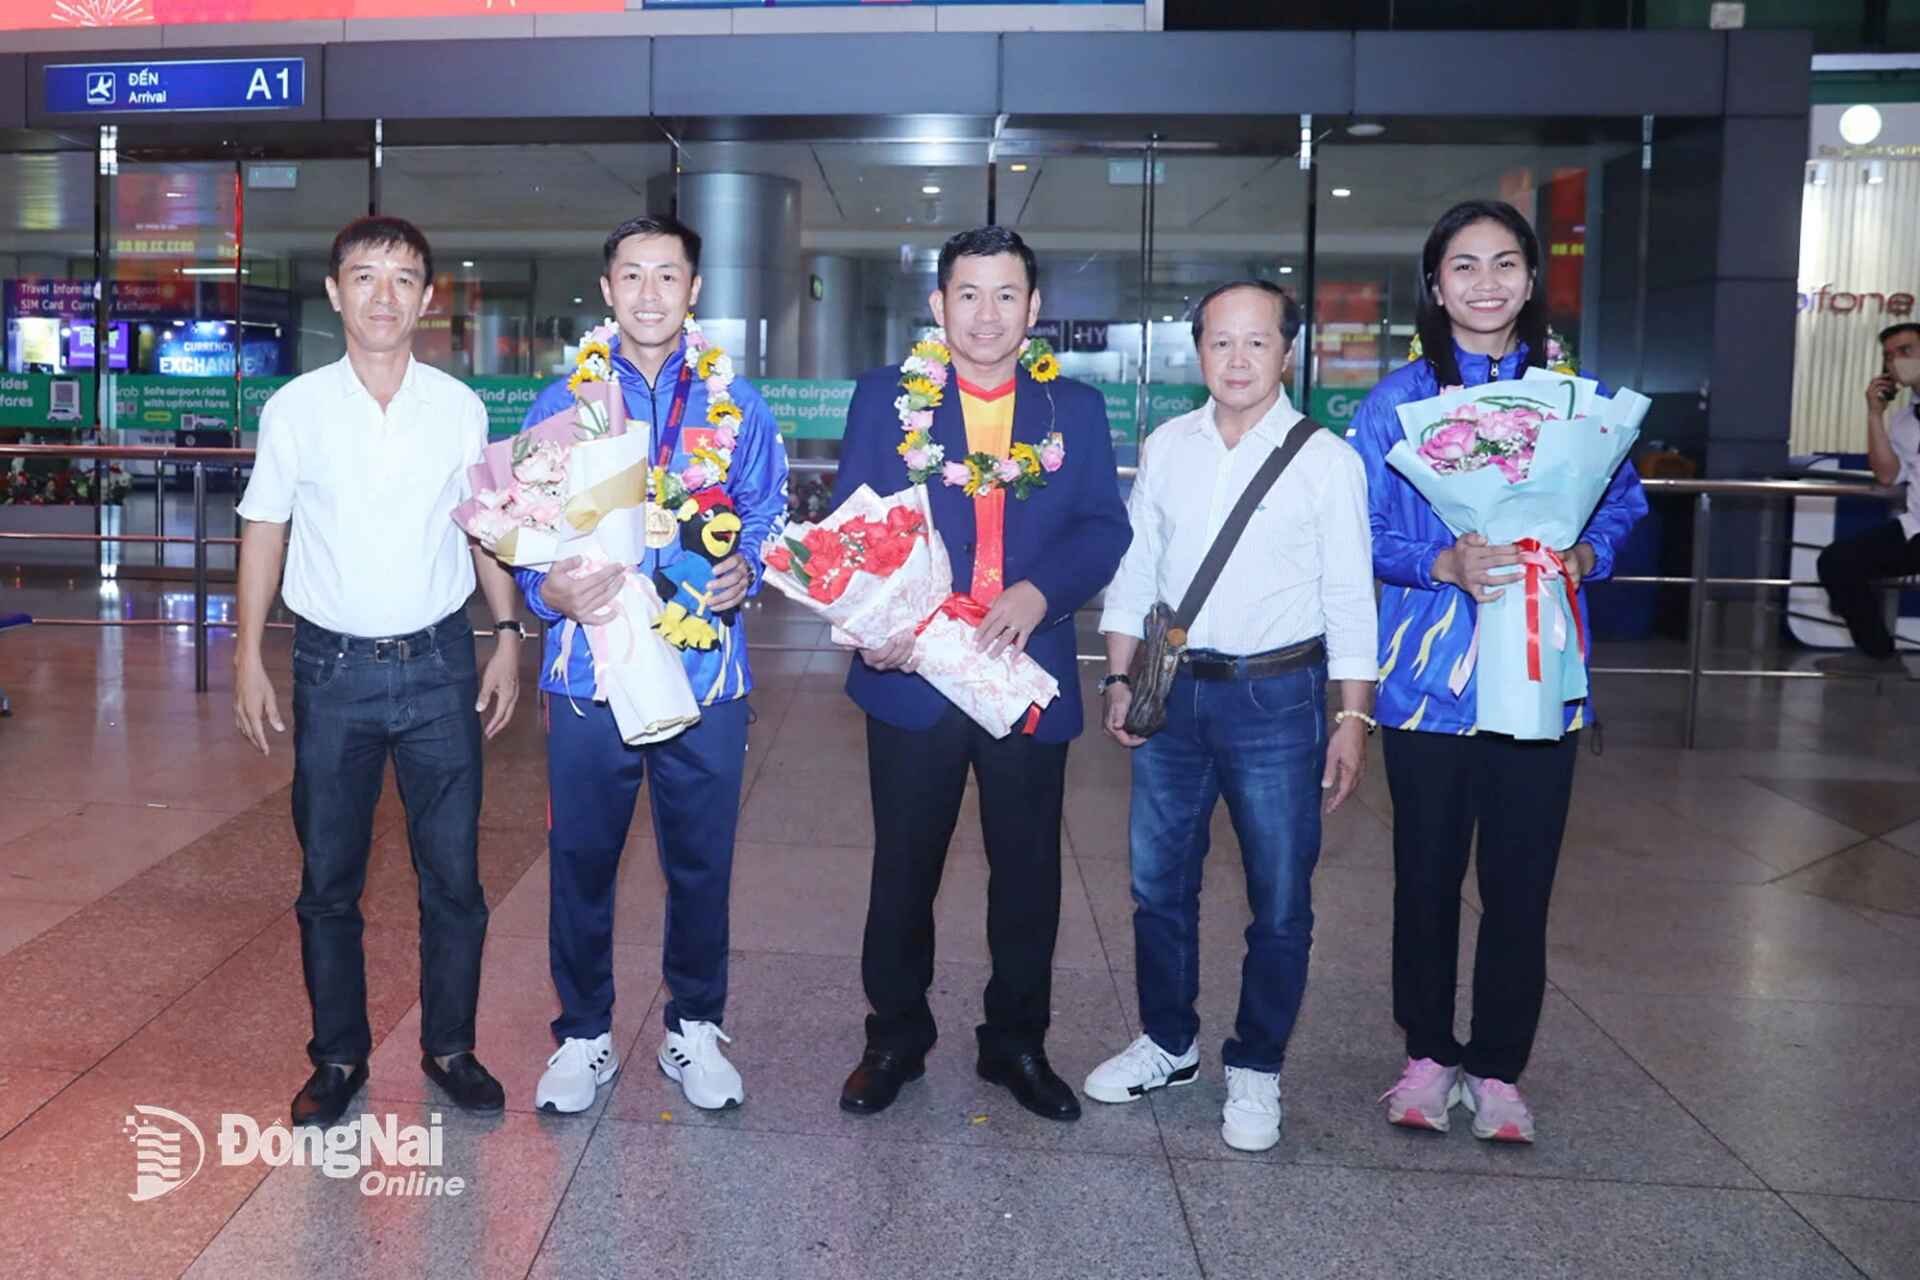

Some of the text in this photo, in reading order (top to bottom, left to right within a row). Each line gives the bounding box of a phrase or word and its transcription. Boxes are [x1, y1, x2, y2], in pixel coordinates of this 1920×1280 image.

[128, 69, 159, 86] ĐẾN
[246, 68, 289, 100] A1
[128, 91, 166, 104] Arrival
[183, 342, 234, 352] CURRENCY
[0, 378, 28, 390] ides
[114, 386, 140, 398] rab
[166, 386, 200, 400] airport
[202, 386, 227, 396] rides
[761, 385, 797, 398] Safe
[1152, 395, 1194, 411] Grab
